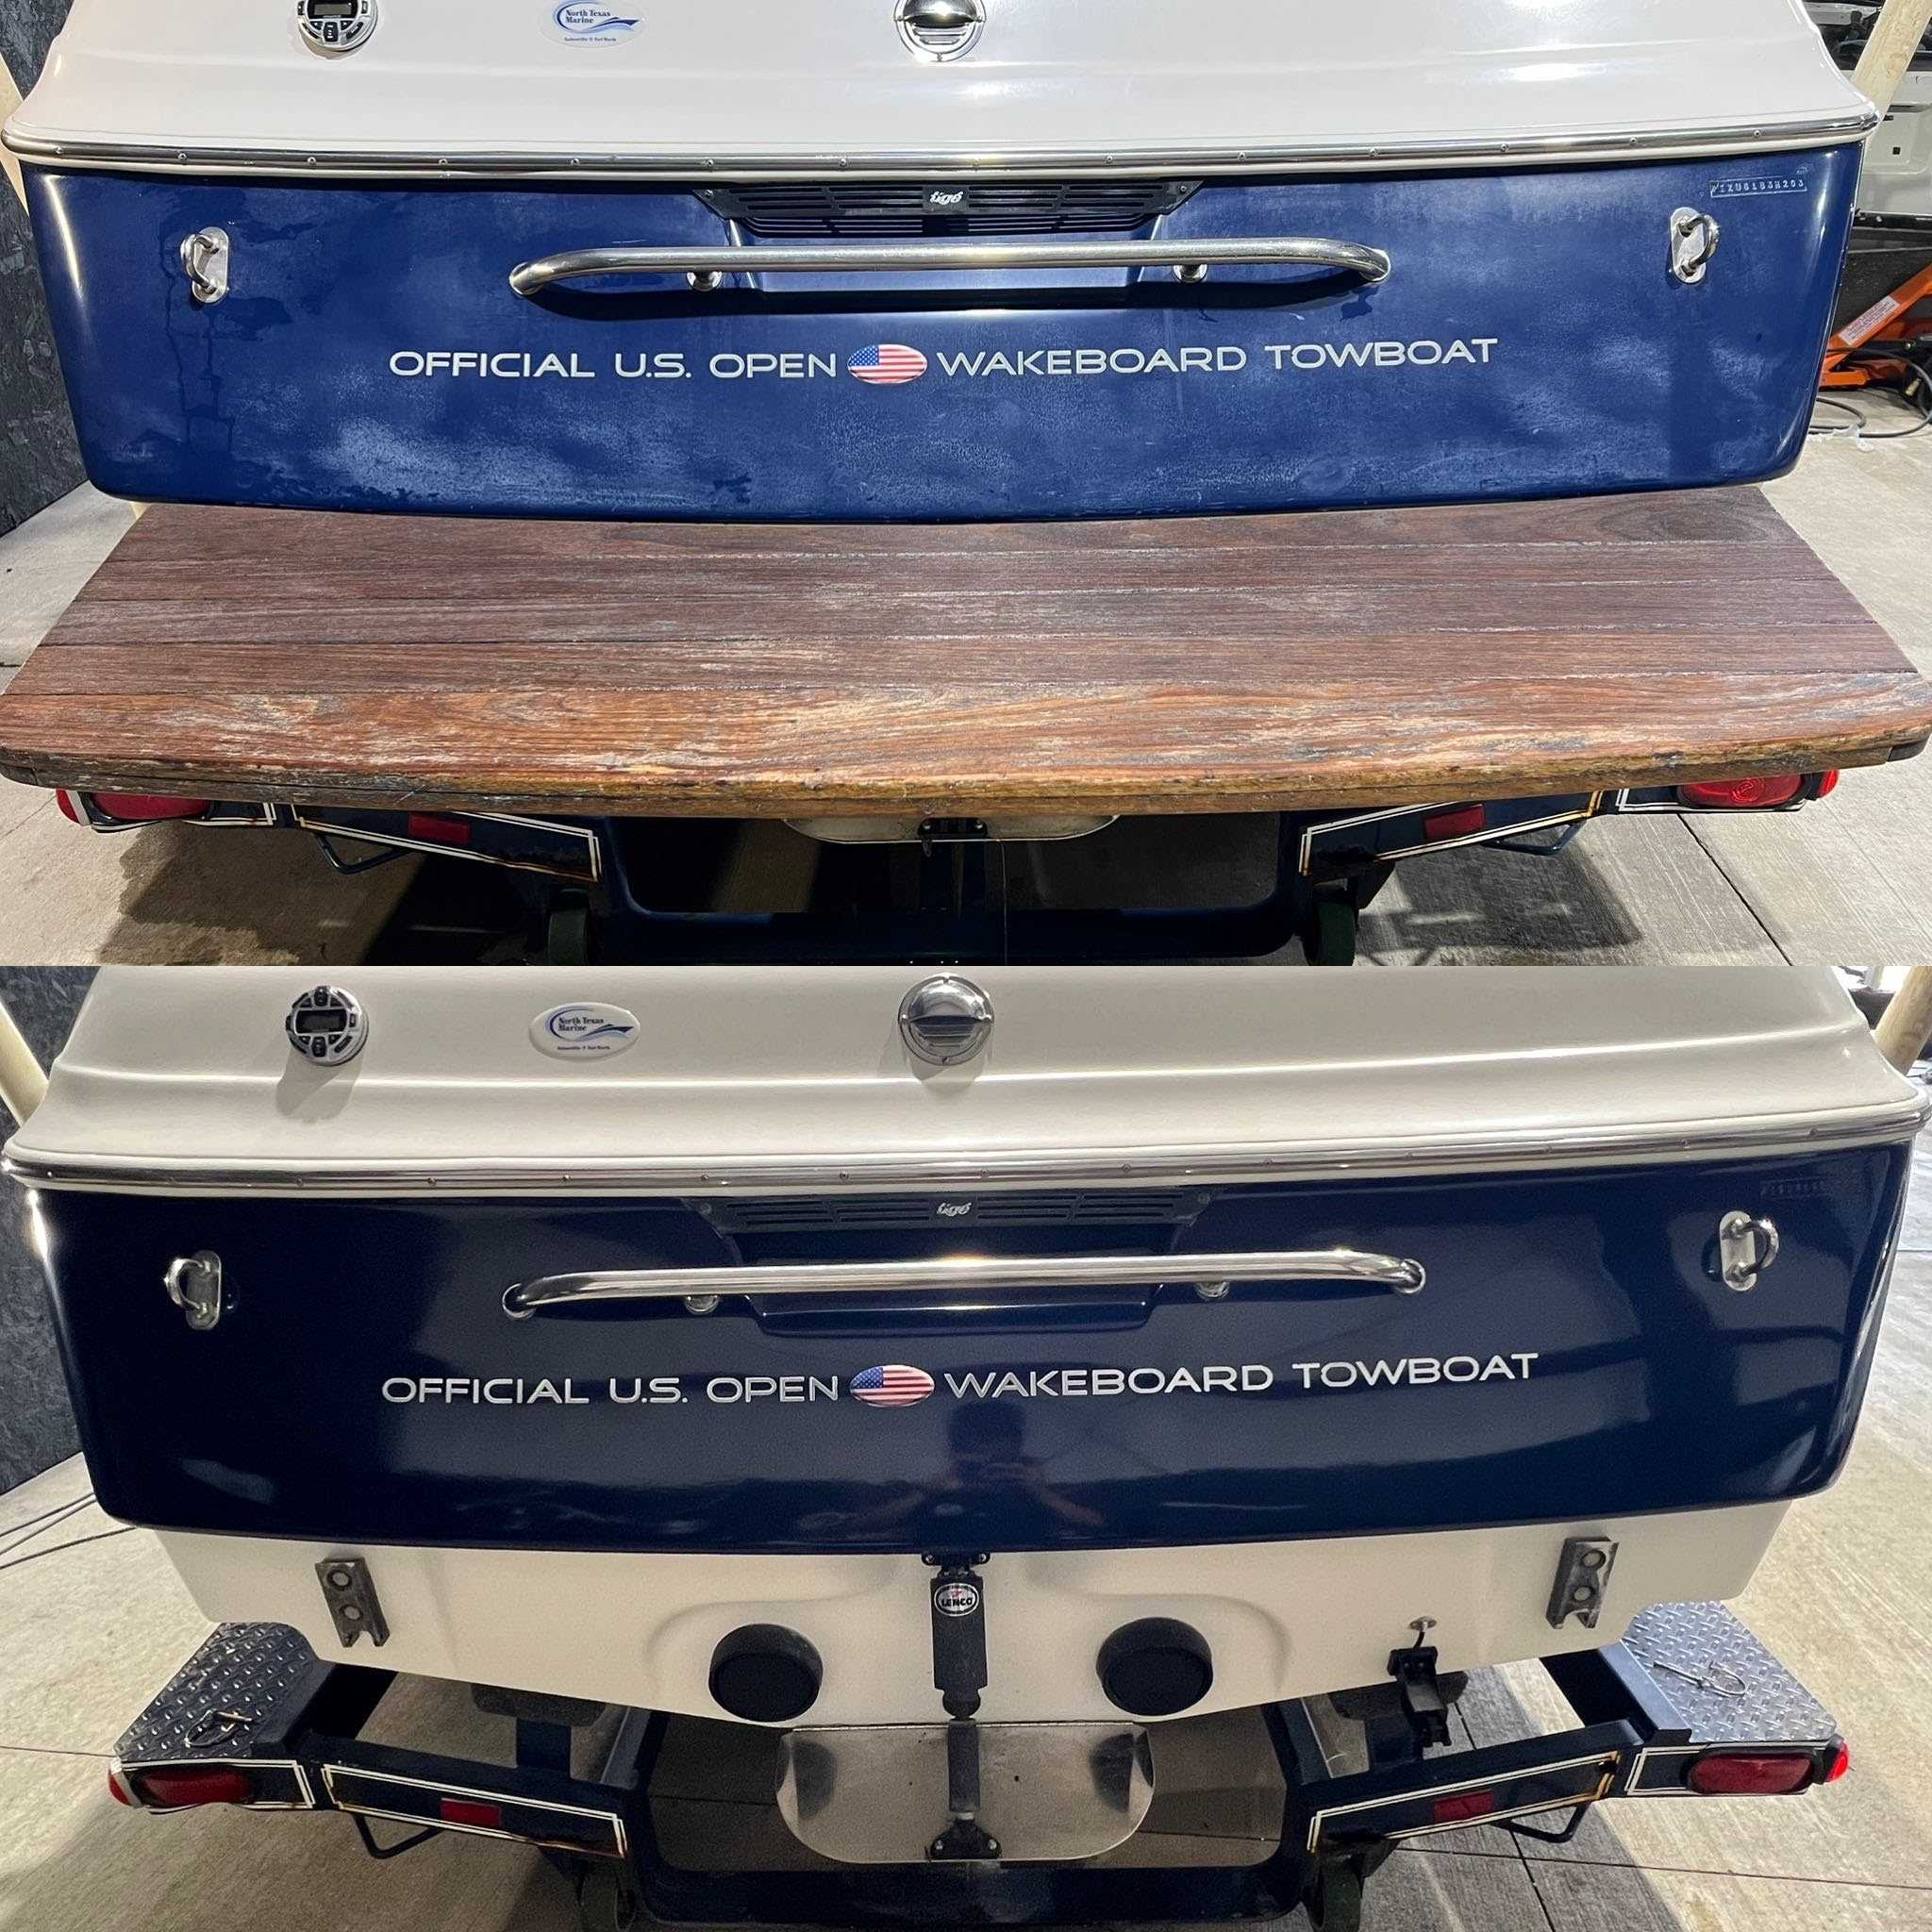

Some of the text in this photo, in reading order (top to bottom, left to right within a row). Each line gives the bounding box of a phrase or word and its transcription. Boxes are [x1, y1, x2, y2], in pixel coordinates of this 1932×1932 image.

[389, 338, 1499, 378] OFFICIAL U.S. OPEN WAKEBOARD TOWBOAT
[381, 1352, 1540, 1405] OFFICIAL U.S. OPEN WAKEBOARD TOWBOAT
[942, 1597, 974, 1607] LENCO
